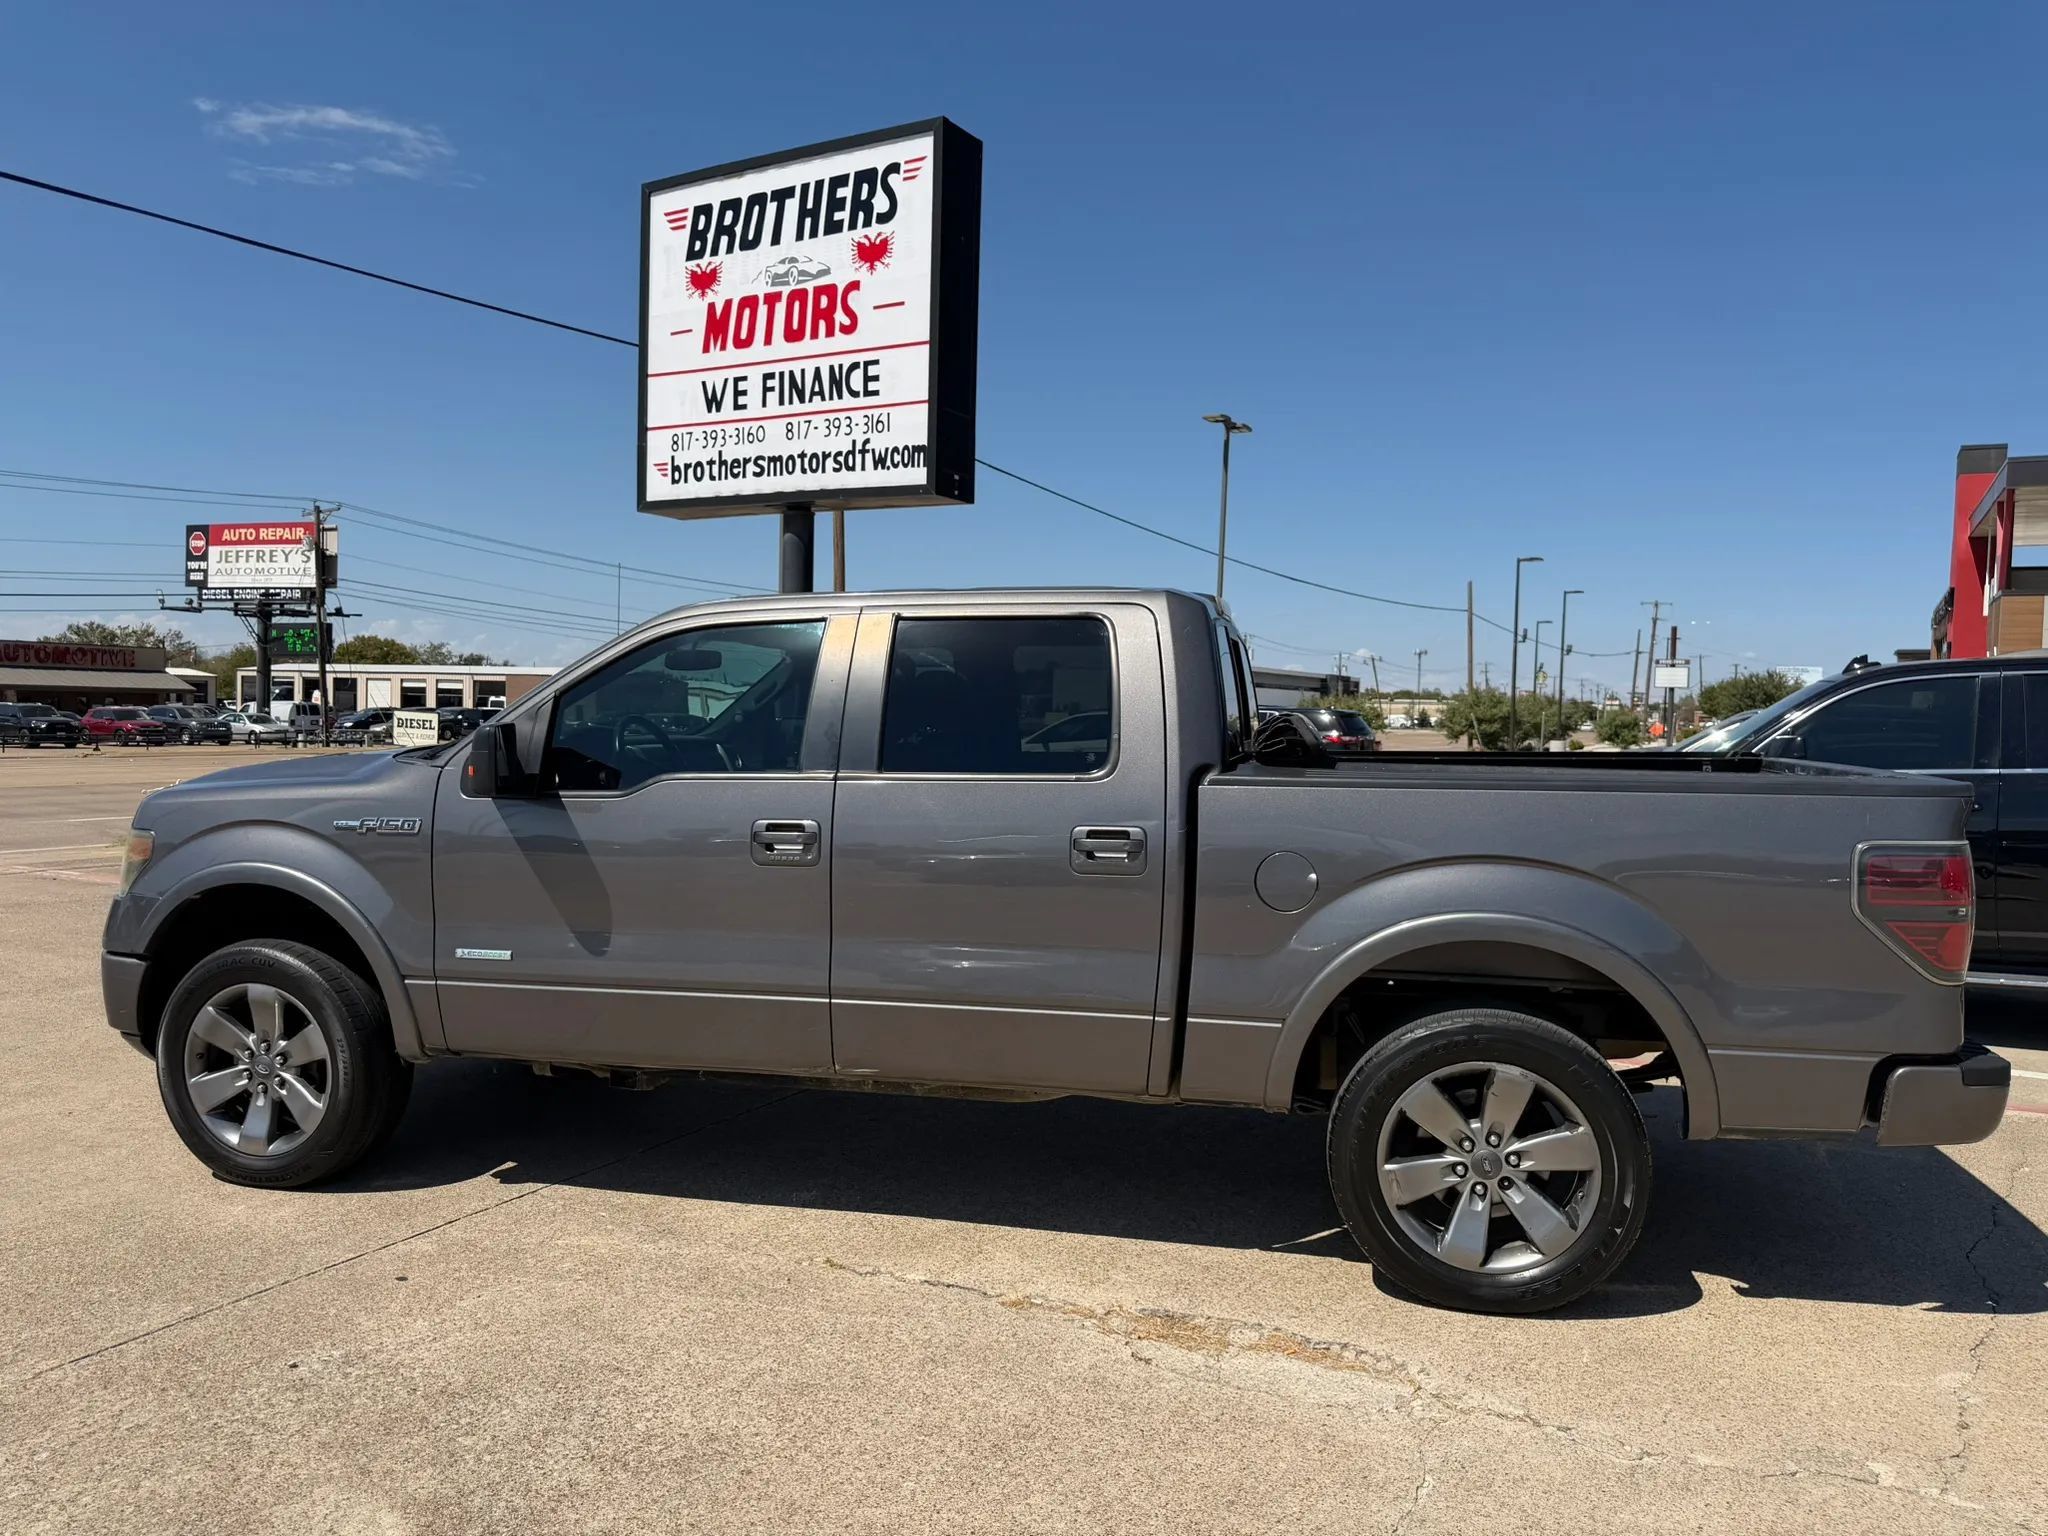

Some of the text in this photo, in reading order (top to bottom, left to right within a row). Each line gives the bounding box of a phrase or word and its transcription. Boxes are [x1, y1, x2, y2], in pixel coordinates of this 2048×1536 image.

[685, 161, 902, 262] BROTHERS
[701, 279, 861, 354] MOTORS
[701, 359, 881, 414] WE FINANCE
[670, 412, 891, 452] 817-393-3160 817-393-3161
[670, 438, 928, 485] brothersmotorsdfw.com
[221, 527, 305, 541] AUTO REPAIR
[215, 549, 312, 564] JEFFREY'S
[214, 566, 312, 576] AUTOMOTIVE
[202, 589, 302, 599] DIESEL ENGINE REPAIR
[396, 718, 435, 730] DIESEL
